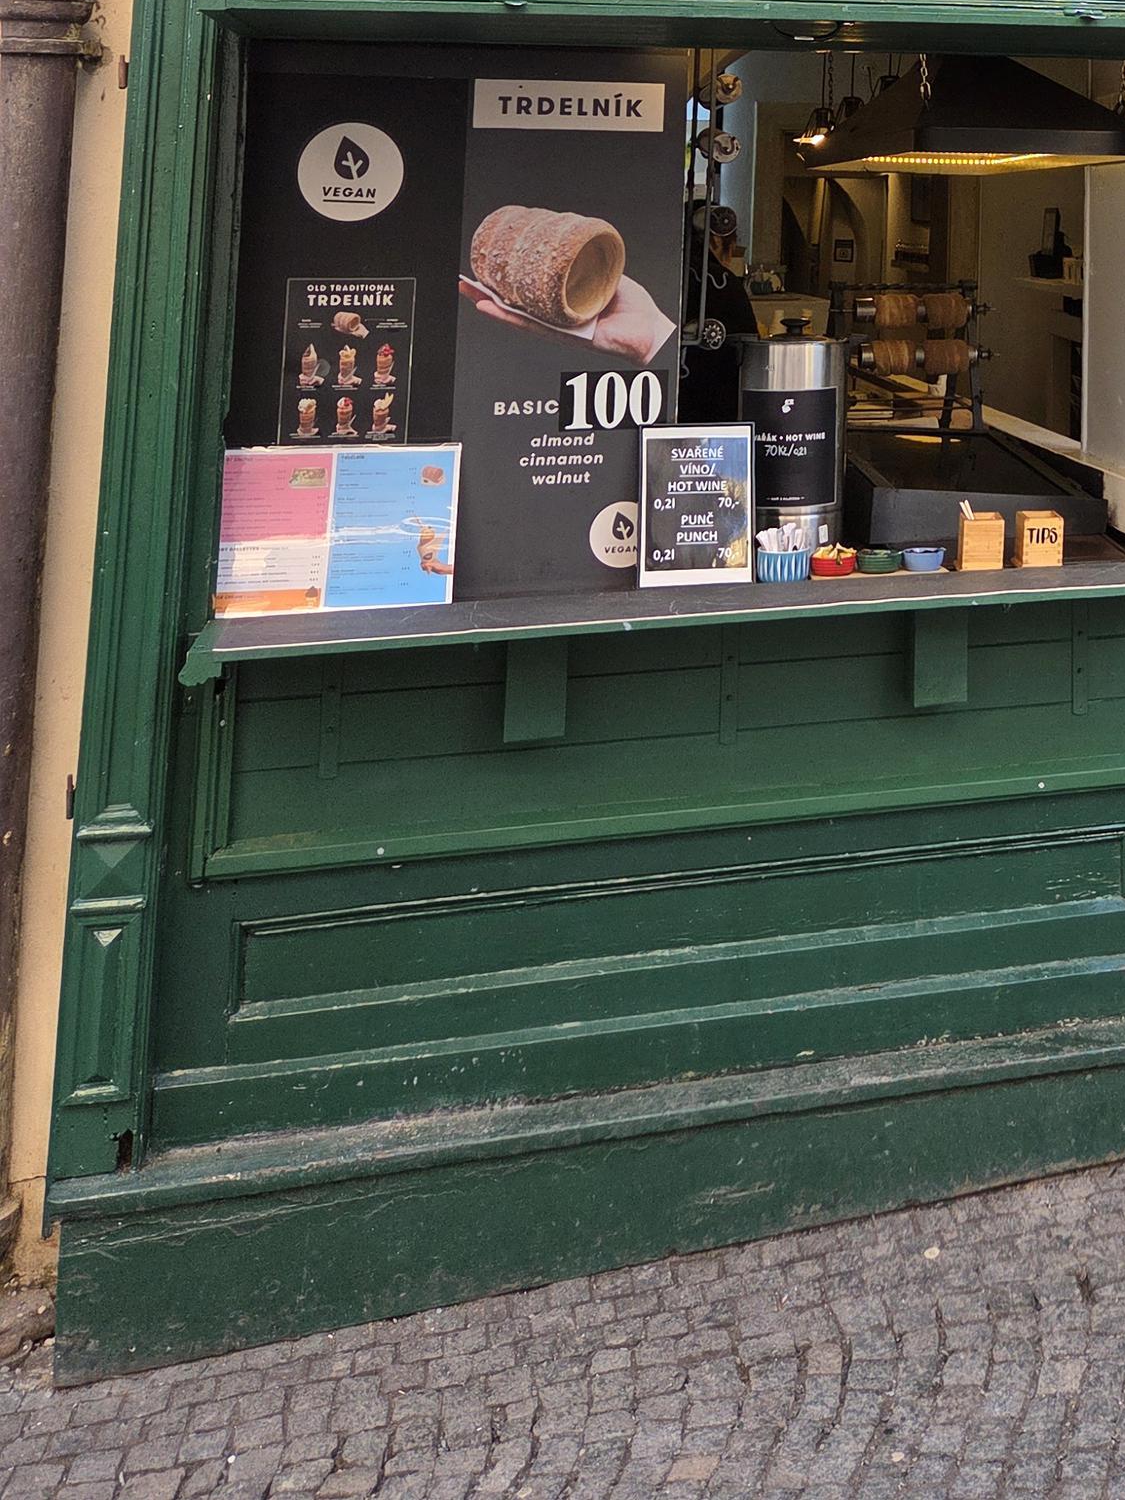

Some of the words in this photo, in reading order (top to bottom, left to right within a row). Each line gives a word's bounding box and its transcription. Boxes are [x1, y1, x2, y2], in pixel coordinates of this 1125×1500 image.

[498, 92, 644, 117] TRDELNÍK
[322, 186, 377, 198] VEGAN
[307, 284, 327, 292] OLD
[330, 283, 395, 292] TRADITIONAL
[307, 290, 394, 307] TRDELNÍK
[494, 399, 560, 416] BASIC
[564, 370, 663, 430] 100
[530, 432, 595, 448] almond
[785, 433, 803, 442] HOT
[804, 432, 826, 441] WINE
[671, 445, 724, 459] SVAŘENÉ
[519, 452, 604, 468] cinnamon
[679, 462, 716, 476] VÍNO/
[532, 471, 592, 485] walnut
[667, 481, 693, 492] HOT
[695, 480, 728, 491] WINE
[718, 497, 740, 510] 70,-
[681, 511, 714, 525] PUNČ
[676, 530, 718, 542] PUNCH
[1026, 527, 1058, 544] TIPS
